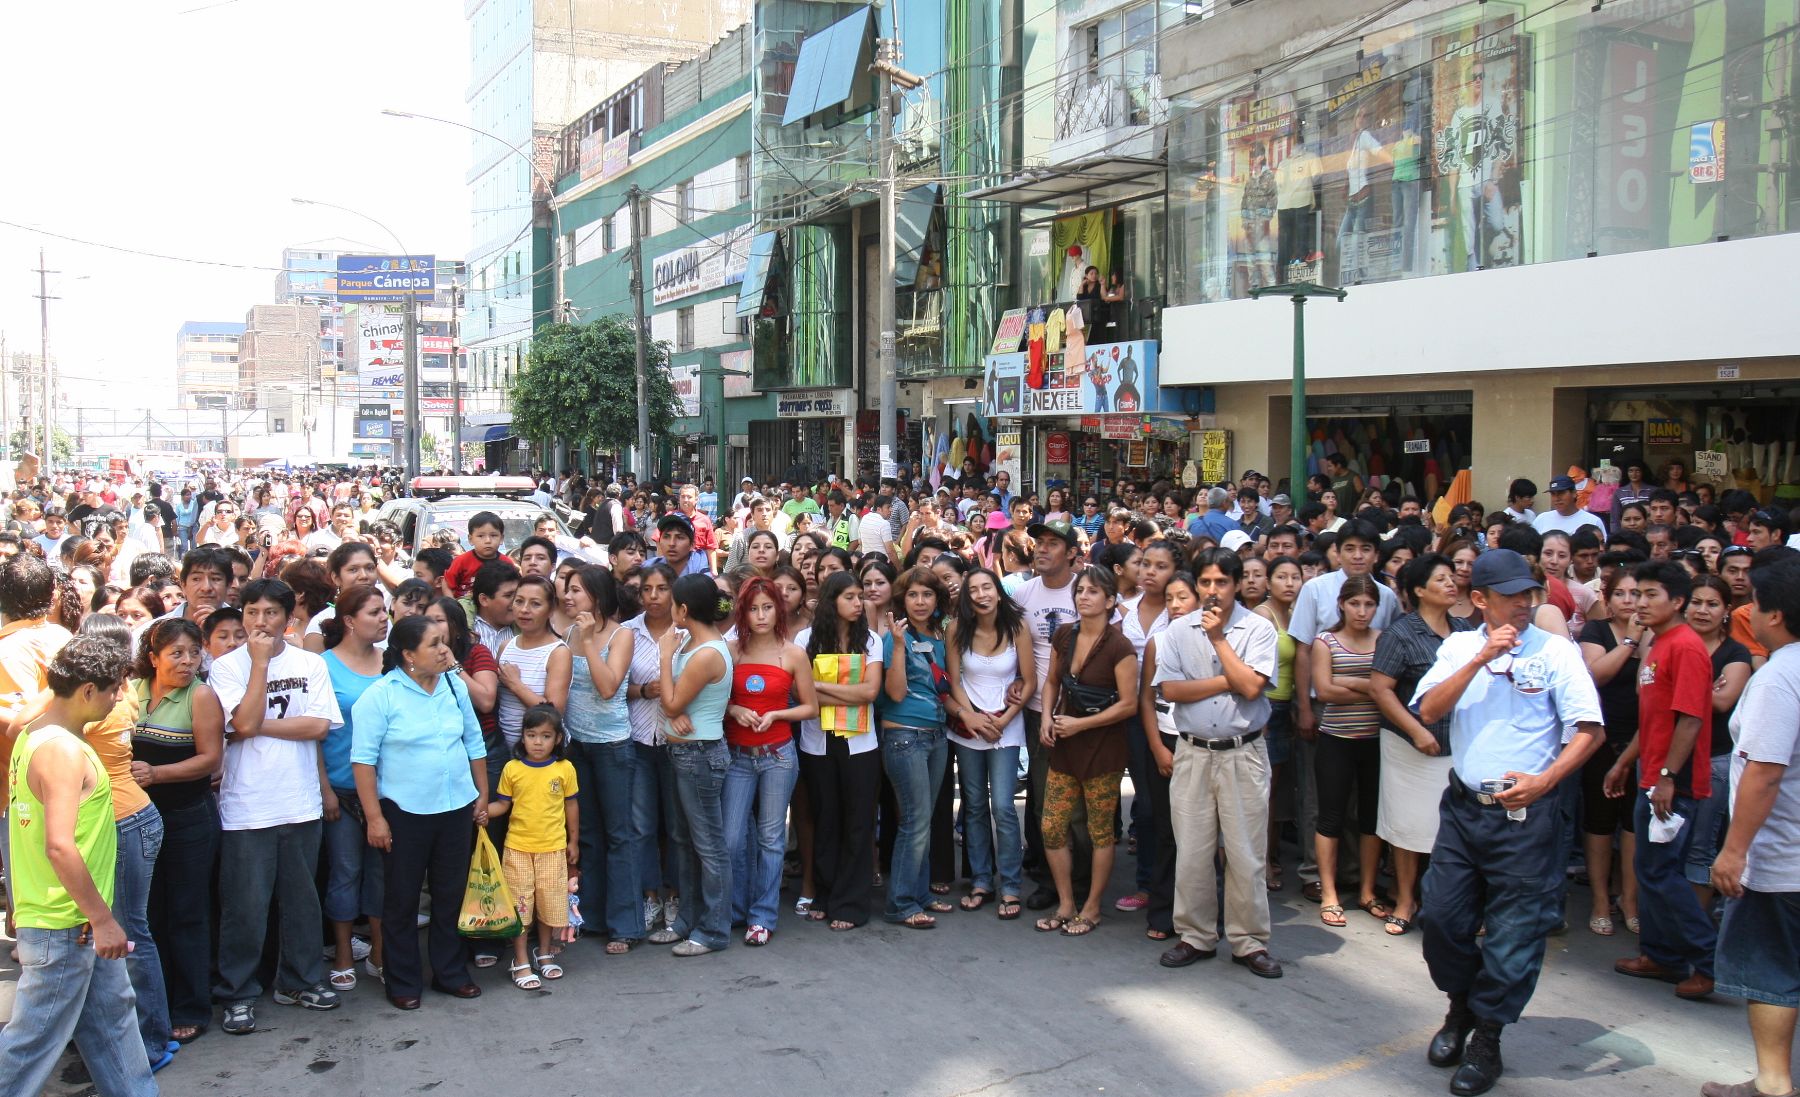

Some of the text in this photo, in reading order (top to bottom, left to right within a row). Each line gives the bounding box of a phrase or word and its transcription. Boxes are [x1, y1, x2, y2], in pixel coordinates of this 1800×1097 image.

[1255, 117, 1291, 133] ATTITUDE
[341, 274, 430, 290] Parque Cánepa
[1033, 390, 1083, 411] NEXTEL
[1649, 419, 1681, 436] BAÑO
[998, 434, 1021, 445] AQUI
[1698, 452, 1722, 460] STAND
[268, 694, 291, 719] 7
